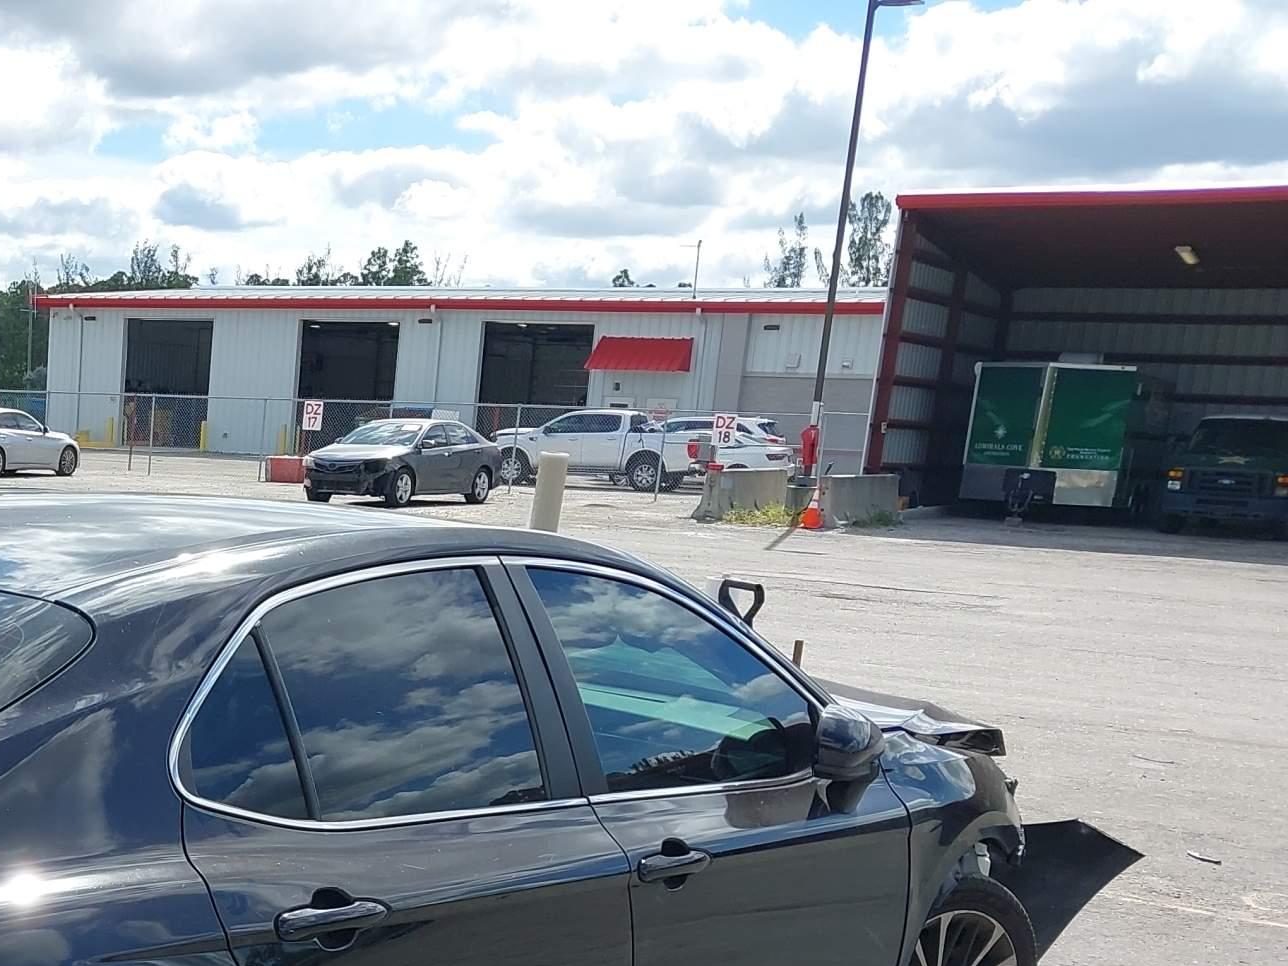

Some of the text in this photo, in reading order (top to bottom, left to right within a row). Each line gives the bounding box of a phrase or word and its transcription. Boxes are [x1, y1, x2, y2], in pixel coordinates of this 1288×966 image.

[305, 403, 322, 416] DZ
[307, 416, 318, 428] 17
[715, 415, 736, 430] DZ
[718, 430, 731, 444] 18
